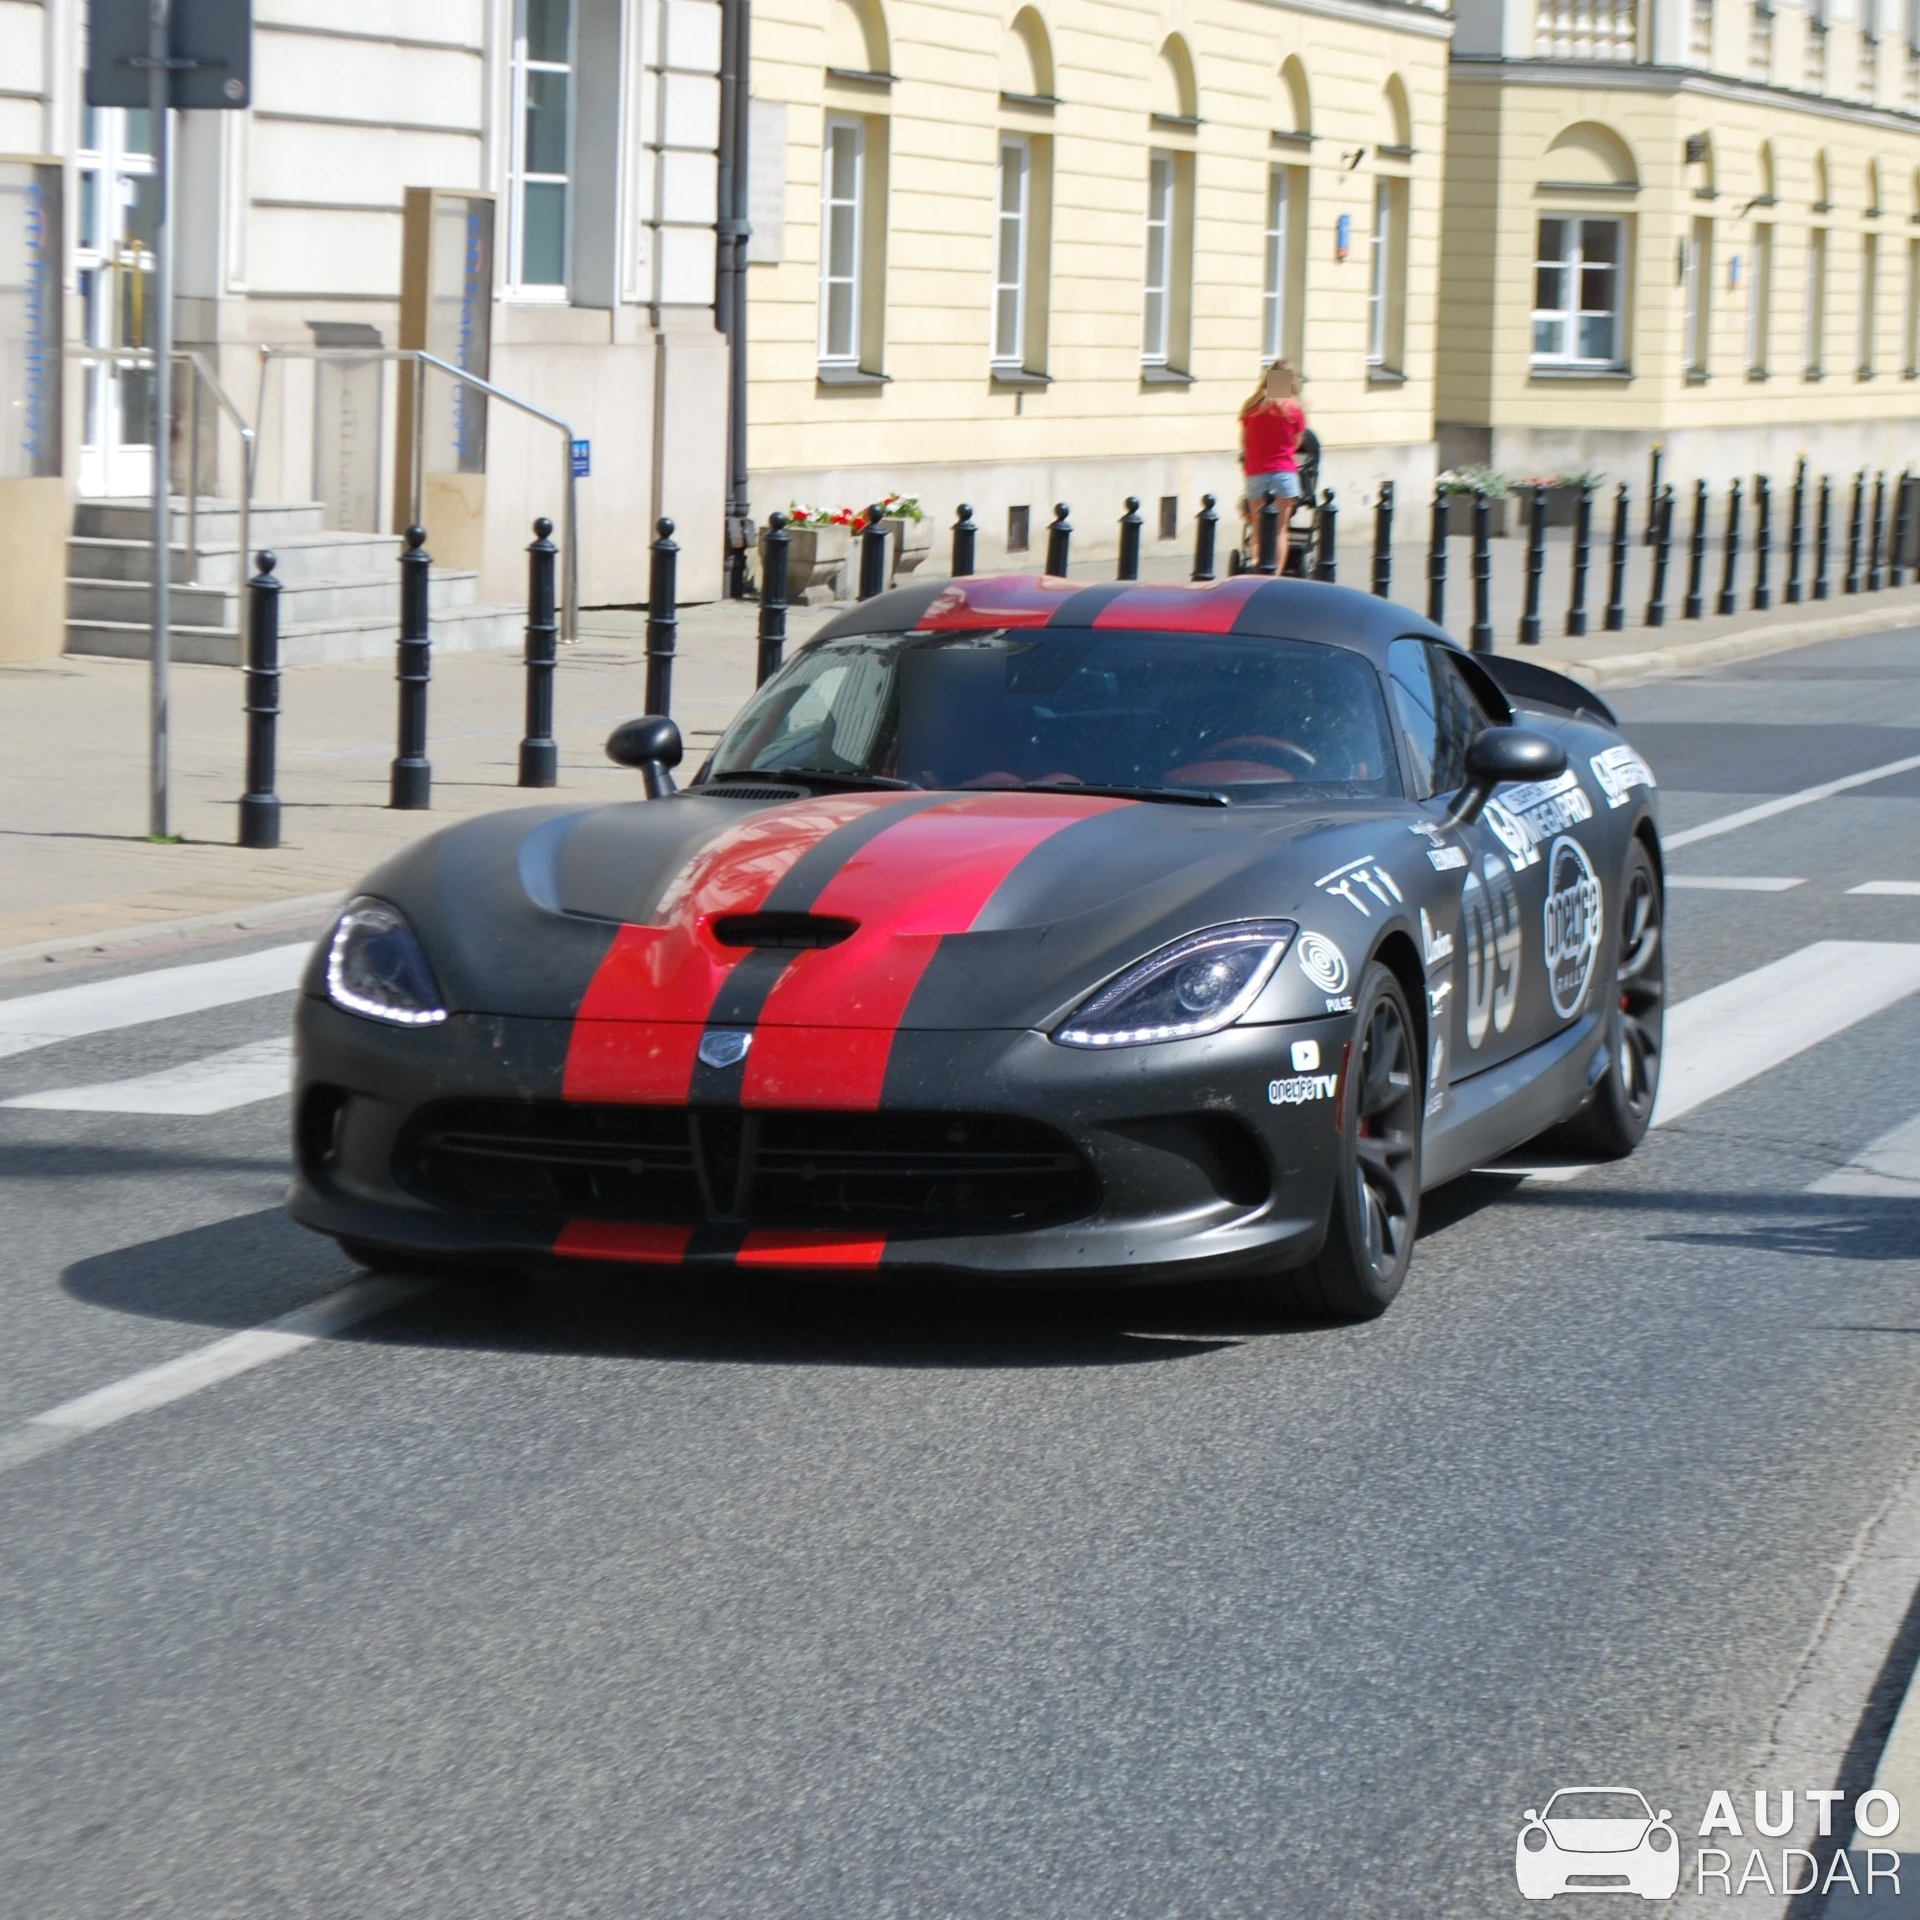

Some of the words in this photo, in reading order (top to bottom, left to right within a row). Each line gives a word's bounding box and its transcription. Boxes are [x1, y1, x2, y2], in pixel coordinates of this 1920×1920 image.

[452, 284, 479, 455] handowy
[1325, 996, 1354, 1012] PULSE
[1461, 853, 1522, 1049] 09
